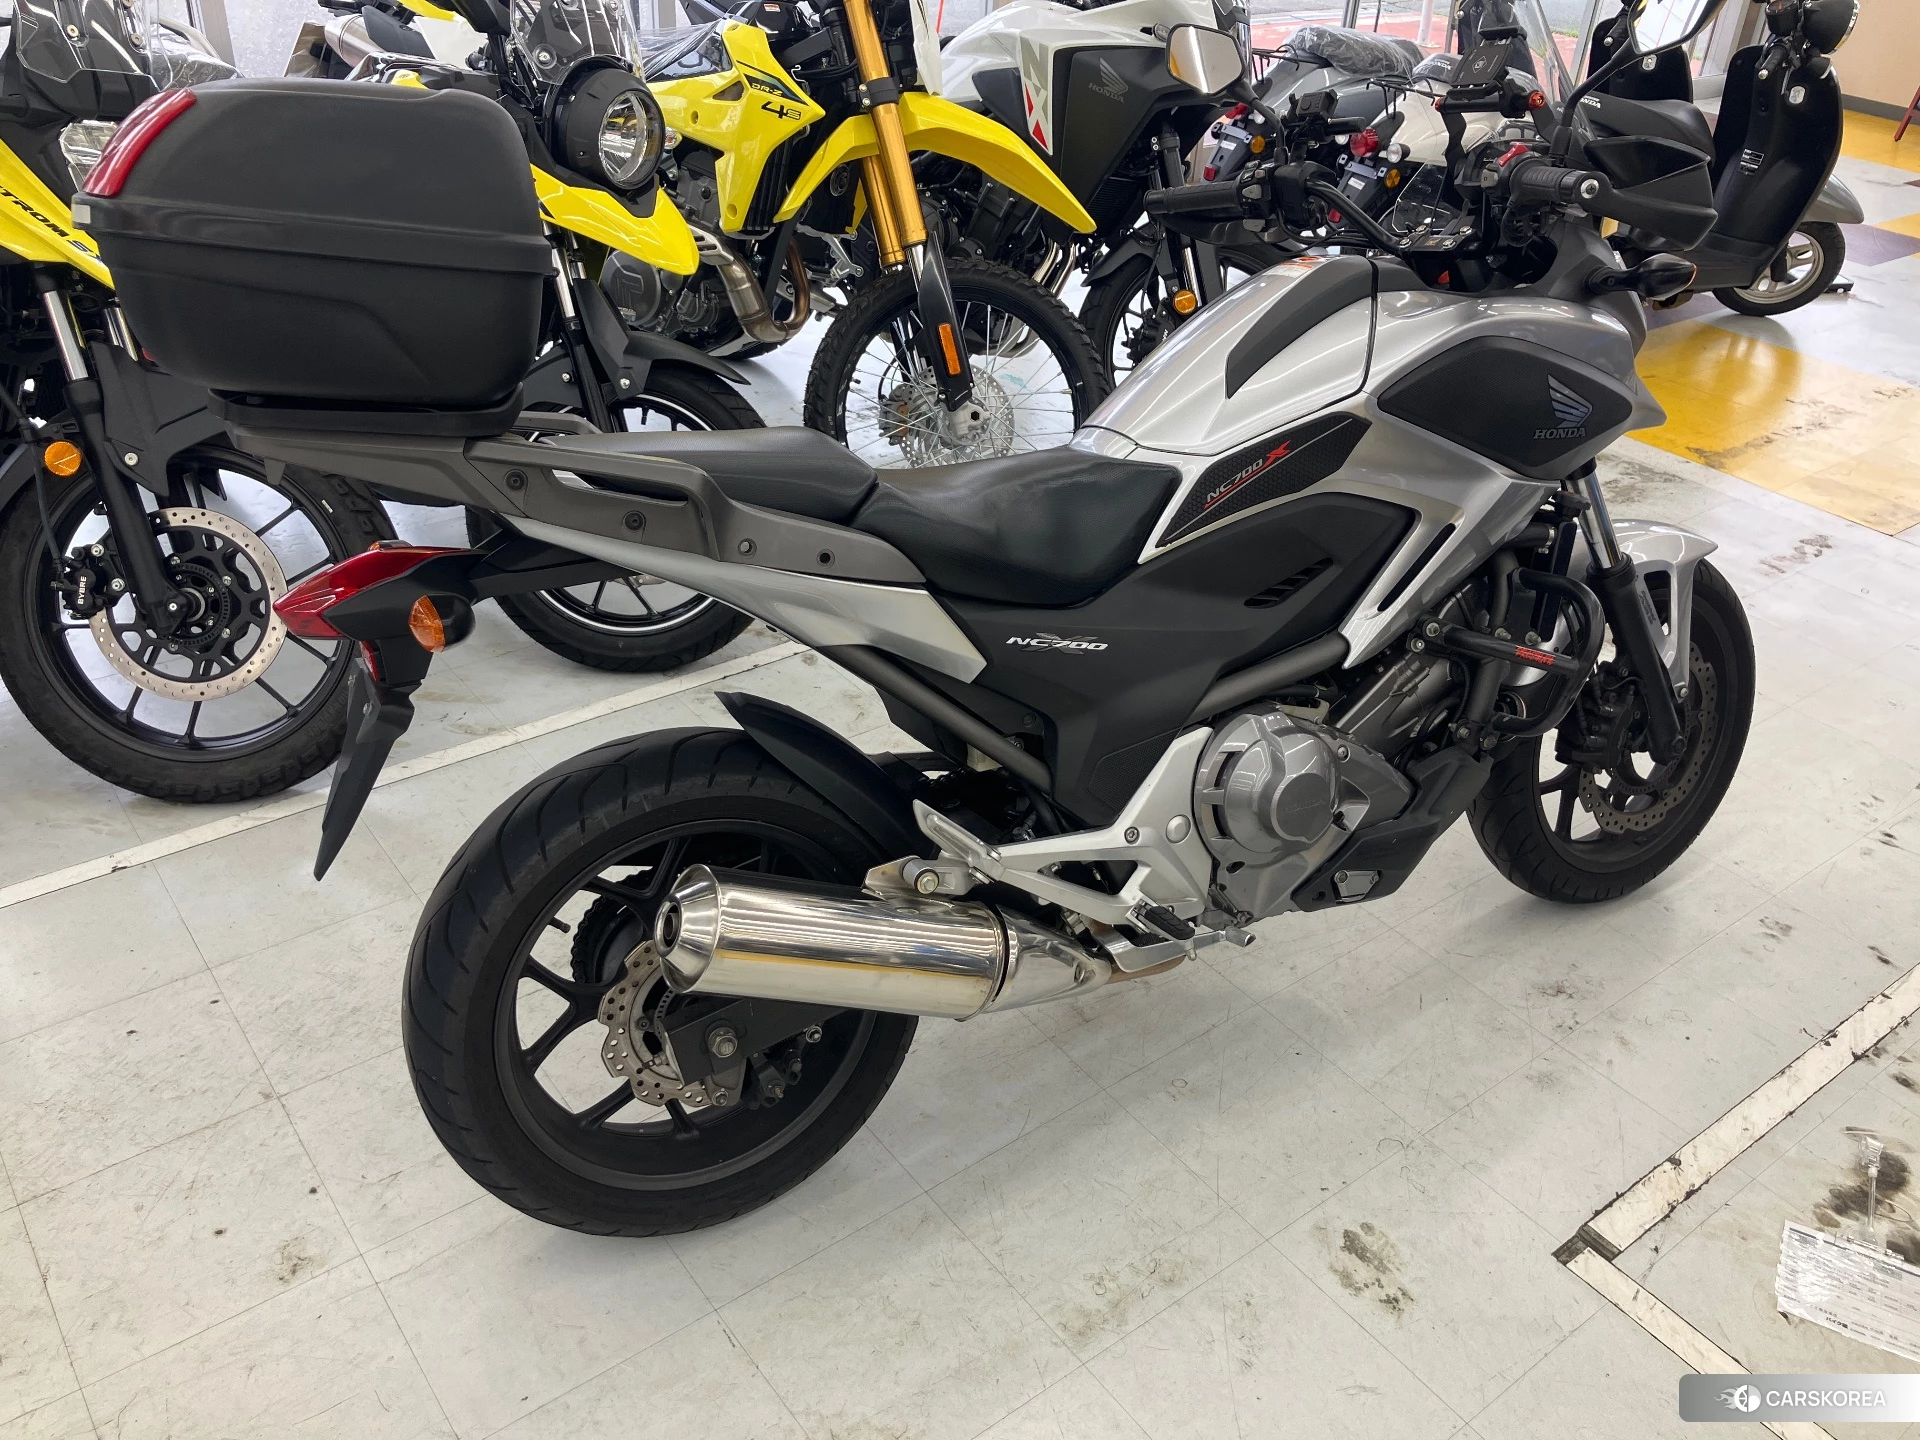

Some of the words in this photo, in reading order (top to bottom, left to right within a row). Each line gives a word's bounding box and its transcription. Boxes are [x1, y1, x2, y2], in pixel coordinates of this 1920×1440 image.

[751, 82, 783, 97] DR-Z
[1088, 82, 1125, 103] HONDA
[0, 185, 70, 238] TROM
[1533, 427, 1587, 440] HONDA
[77, 575, 88, 605] BYBRE
